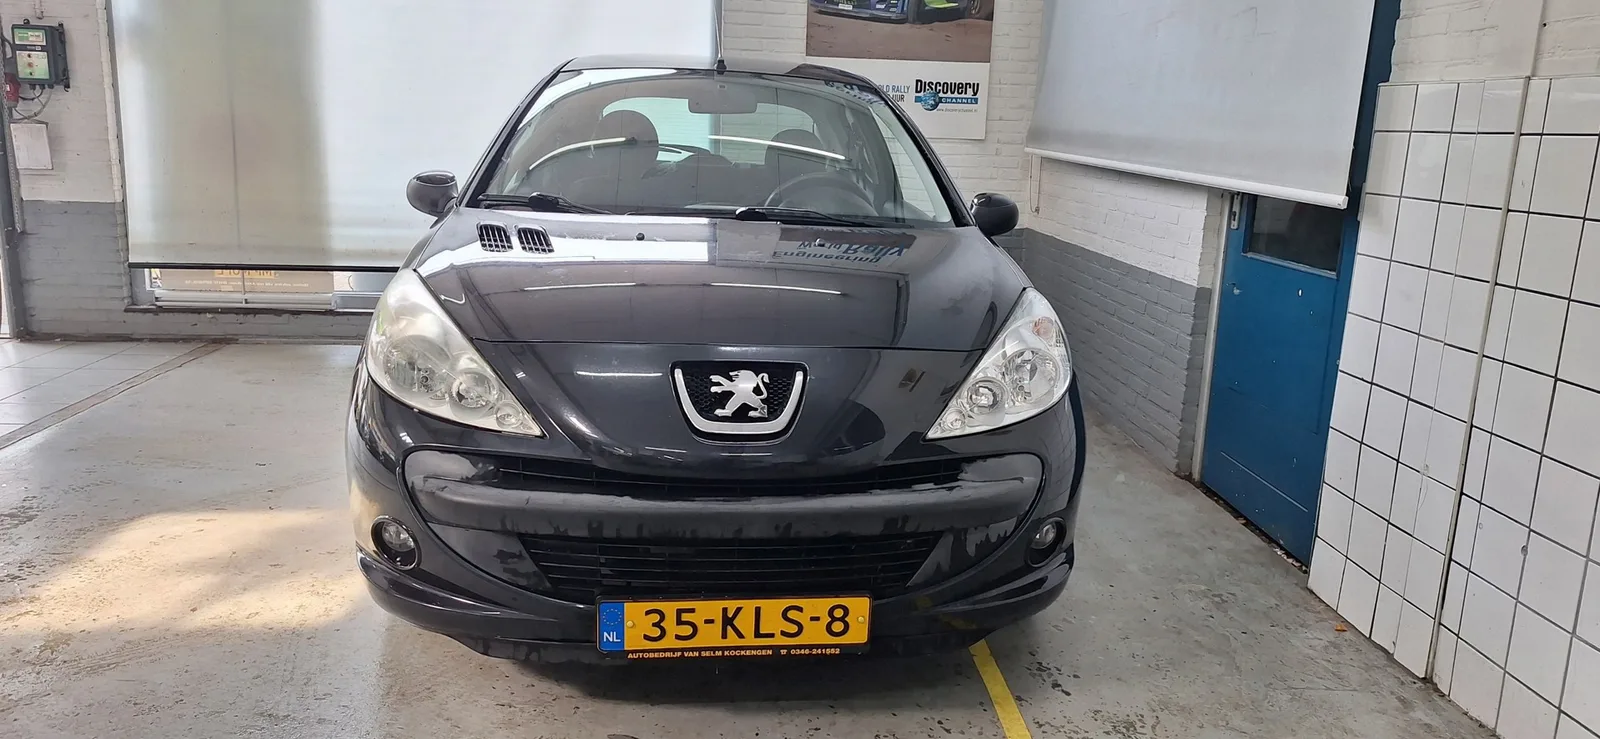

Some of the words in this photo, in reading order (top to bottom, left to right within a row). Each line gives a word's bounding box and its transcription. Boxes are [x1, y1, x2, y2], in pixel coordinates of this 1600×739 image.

[891, 84, 911, 93] RALLY
[915, 79, 979, 96] Discovery
[642, 604, 850, 643] 35-KLS-8
[603, 631, 621, 642] NL
[627, 651, 682, 659] AUTOBEDRIJF
[724, 649, 773, 657] KOCKENGEN
[790, 648, 841, 656] 0346-241552
